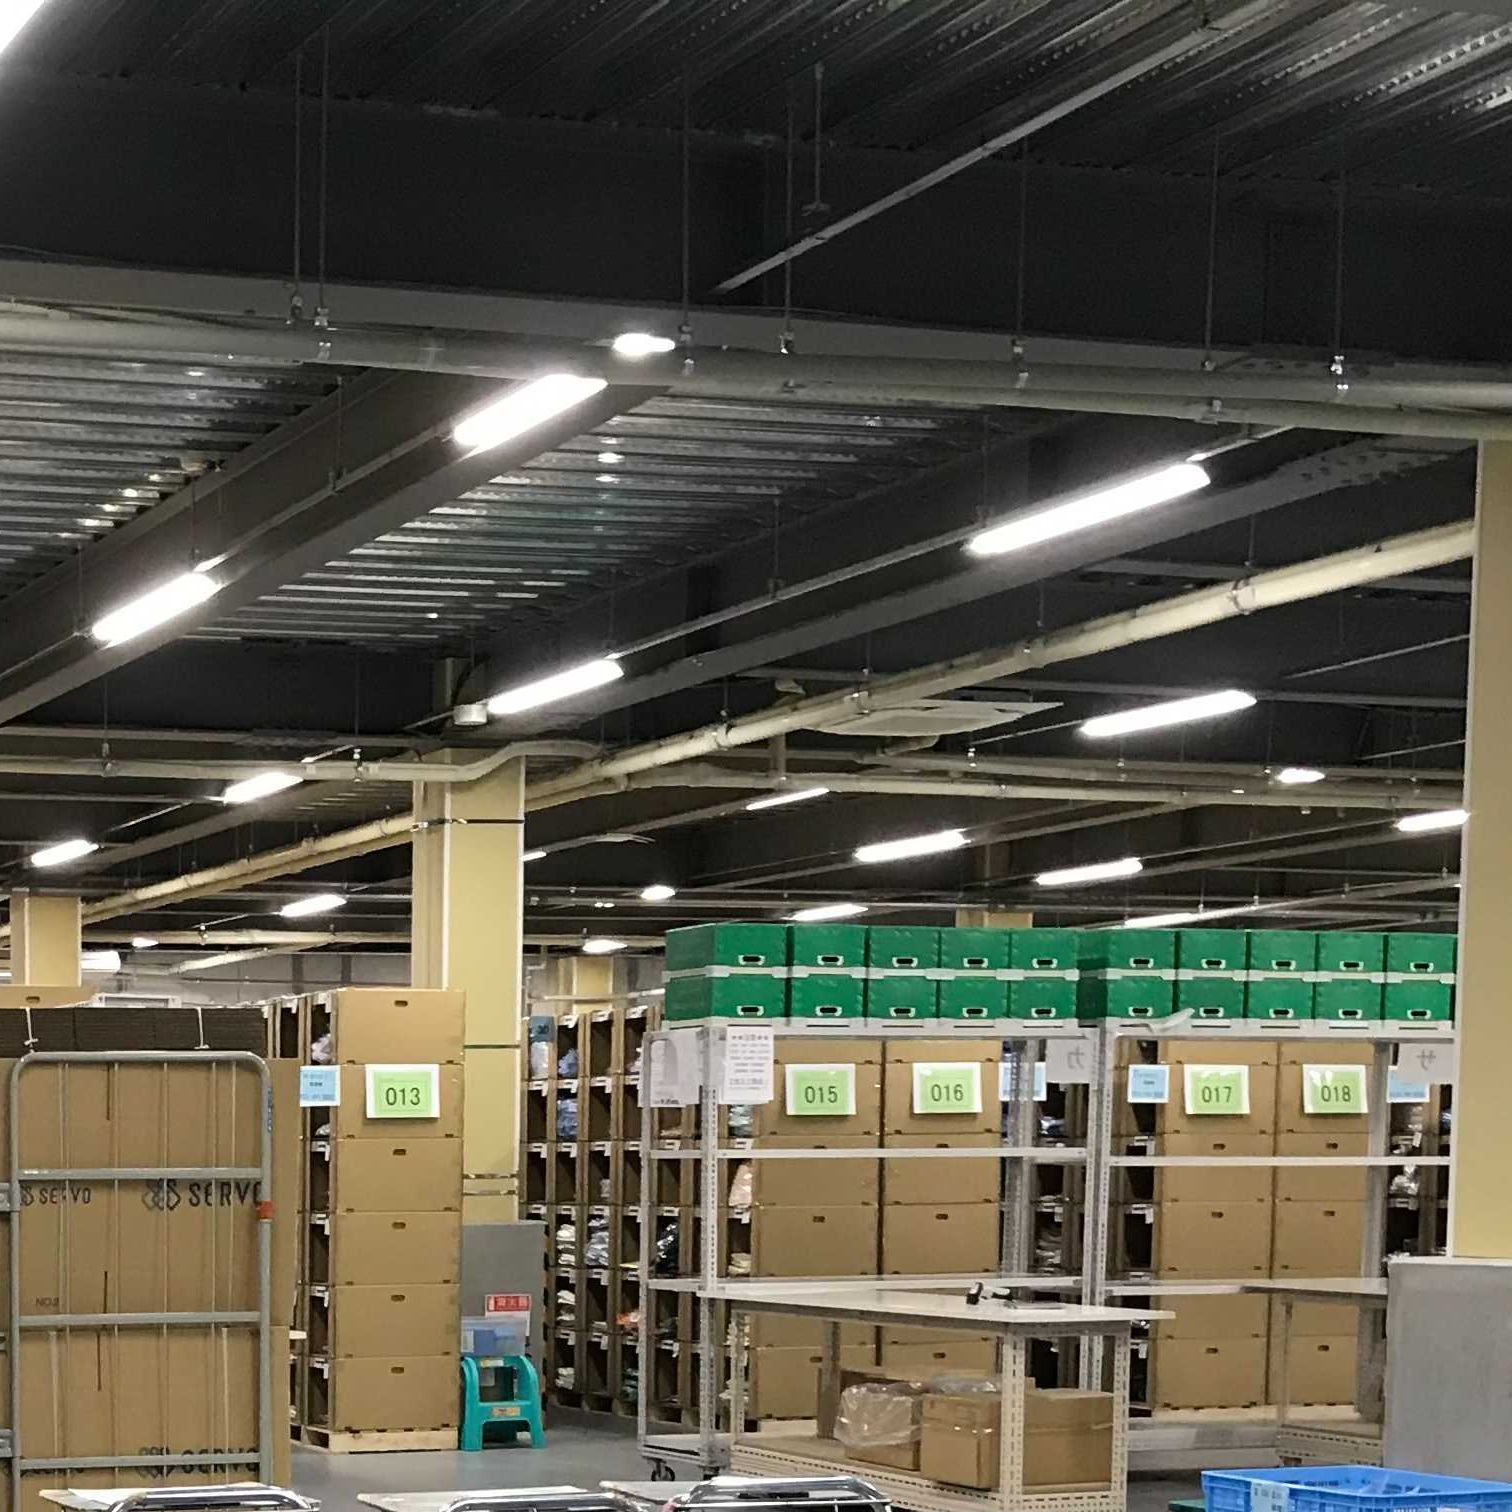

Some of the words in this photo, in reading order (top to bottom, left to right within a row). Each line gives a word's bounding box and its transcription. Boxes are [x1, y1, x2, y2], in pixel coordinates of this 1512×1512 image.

[385, 1087, 421, 1106] 013
[804, 1085, 838, 1104] 015
[931, 1084, 964, 1102] 016
[1201, 1086, 1232, 1103] 017
[1321, 1085, 1351, 1103] 018
